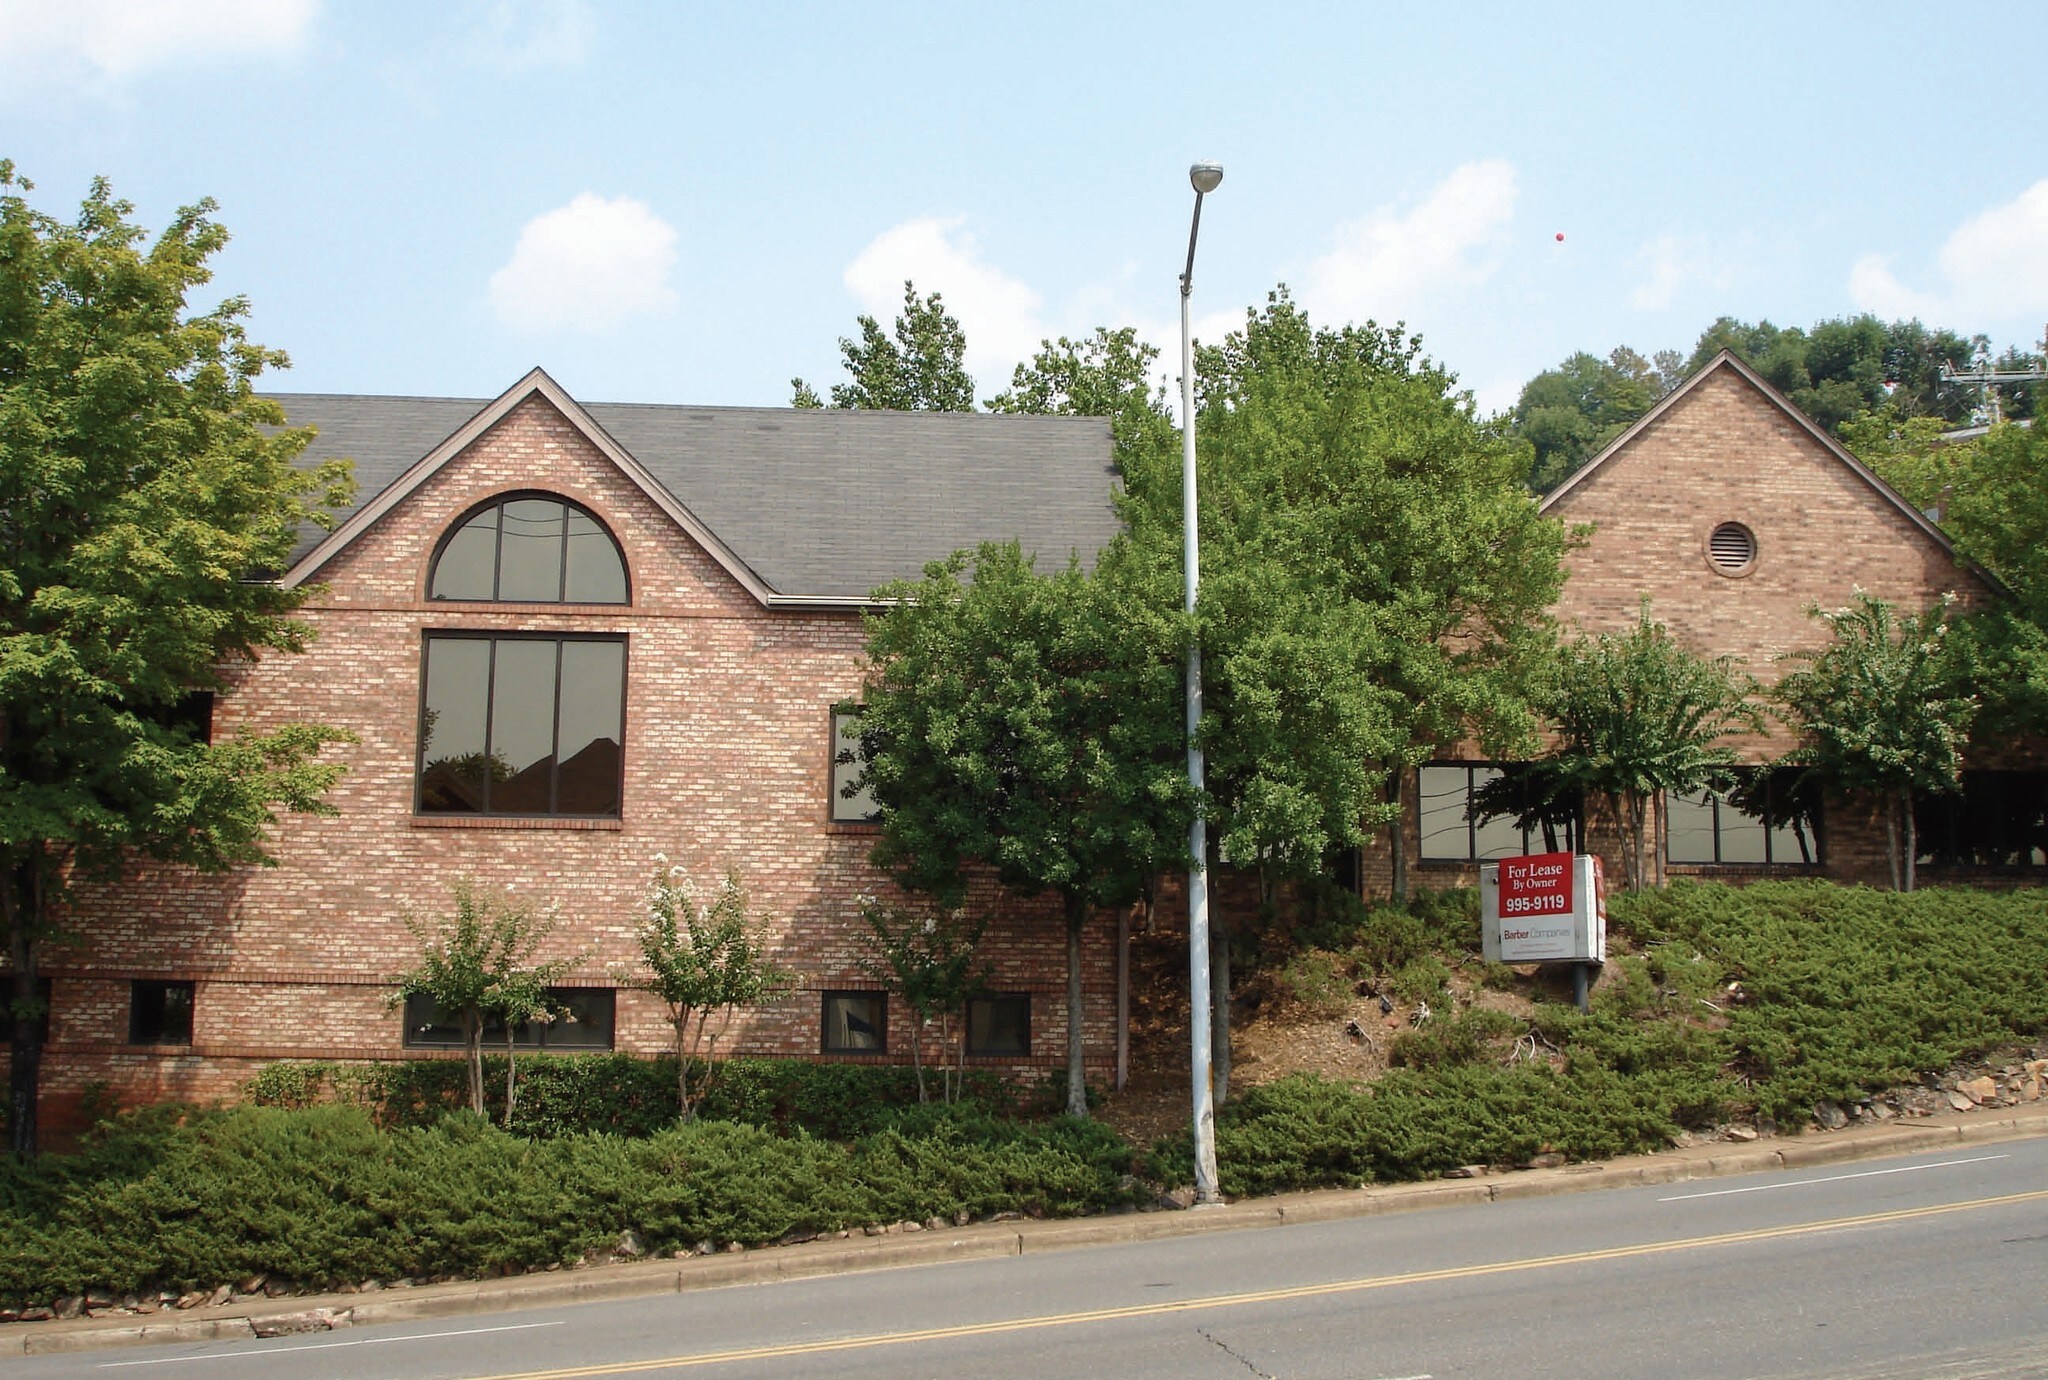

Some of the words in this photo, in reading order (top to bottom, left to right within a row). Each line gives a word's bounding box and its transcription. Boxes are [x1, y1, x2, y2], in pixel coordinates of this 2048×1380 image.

[1508, 865, 1527, 879] For
[1530, 863, 1563, 877] Lease
[1513, 880, 1525, 892] By
[1526, 878, 1557, 889] Owner
[1506, 894, 1565, 912] 995-9119
[1504, 929, 1529, 940] Barber
